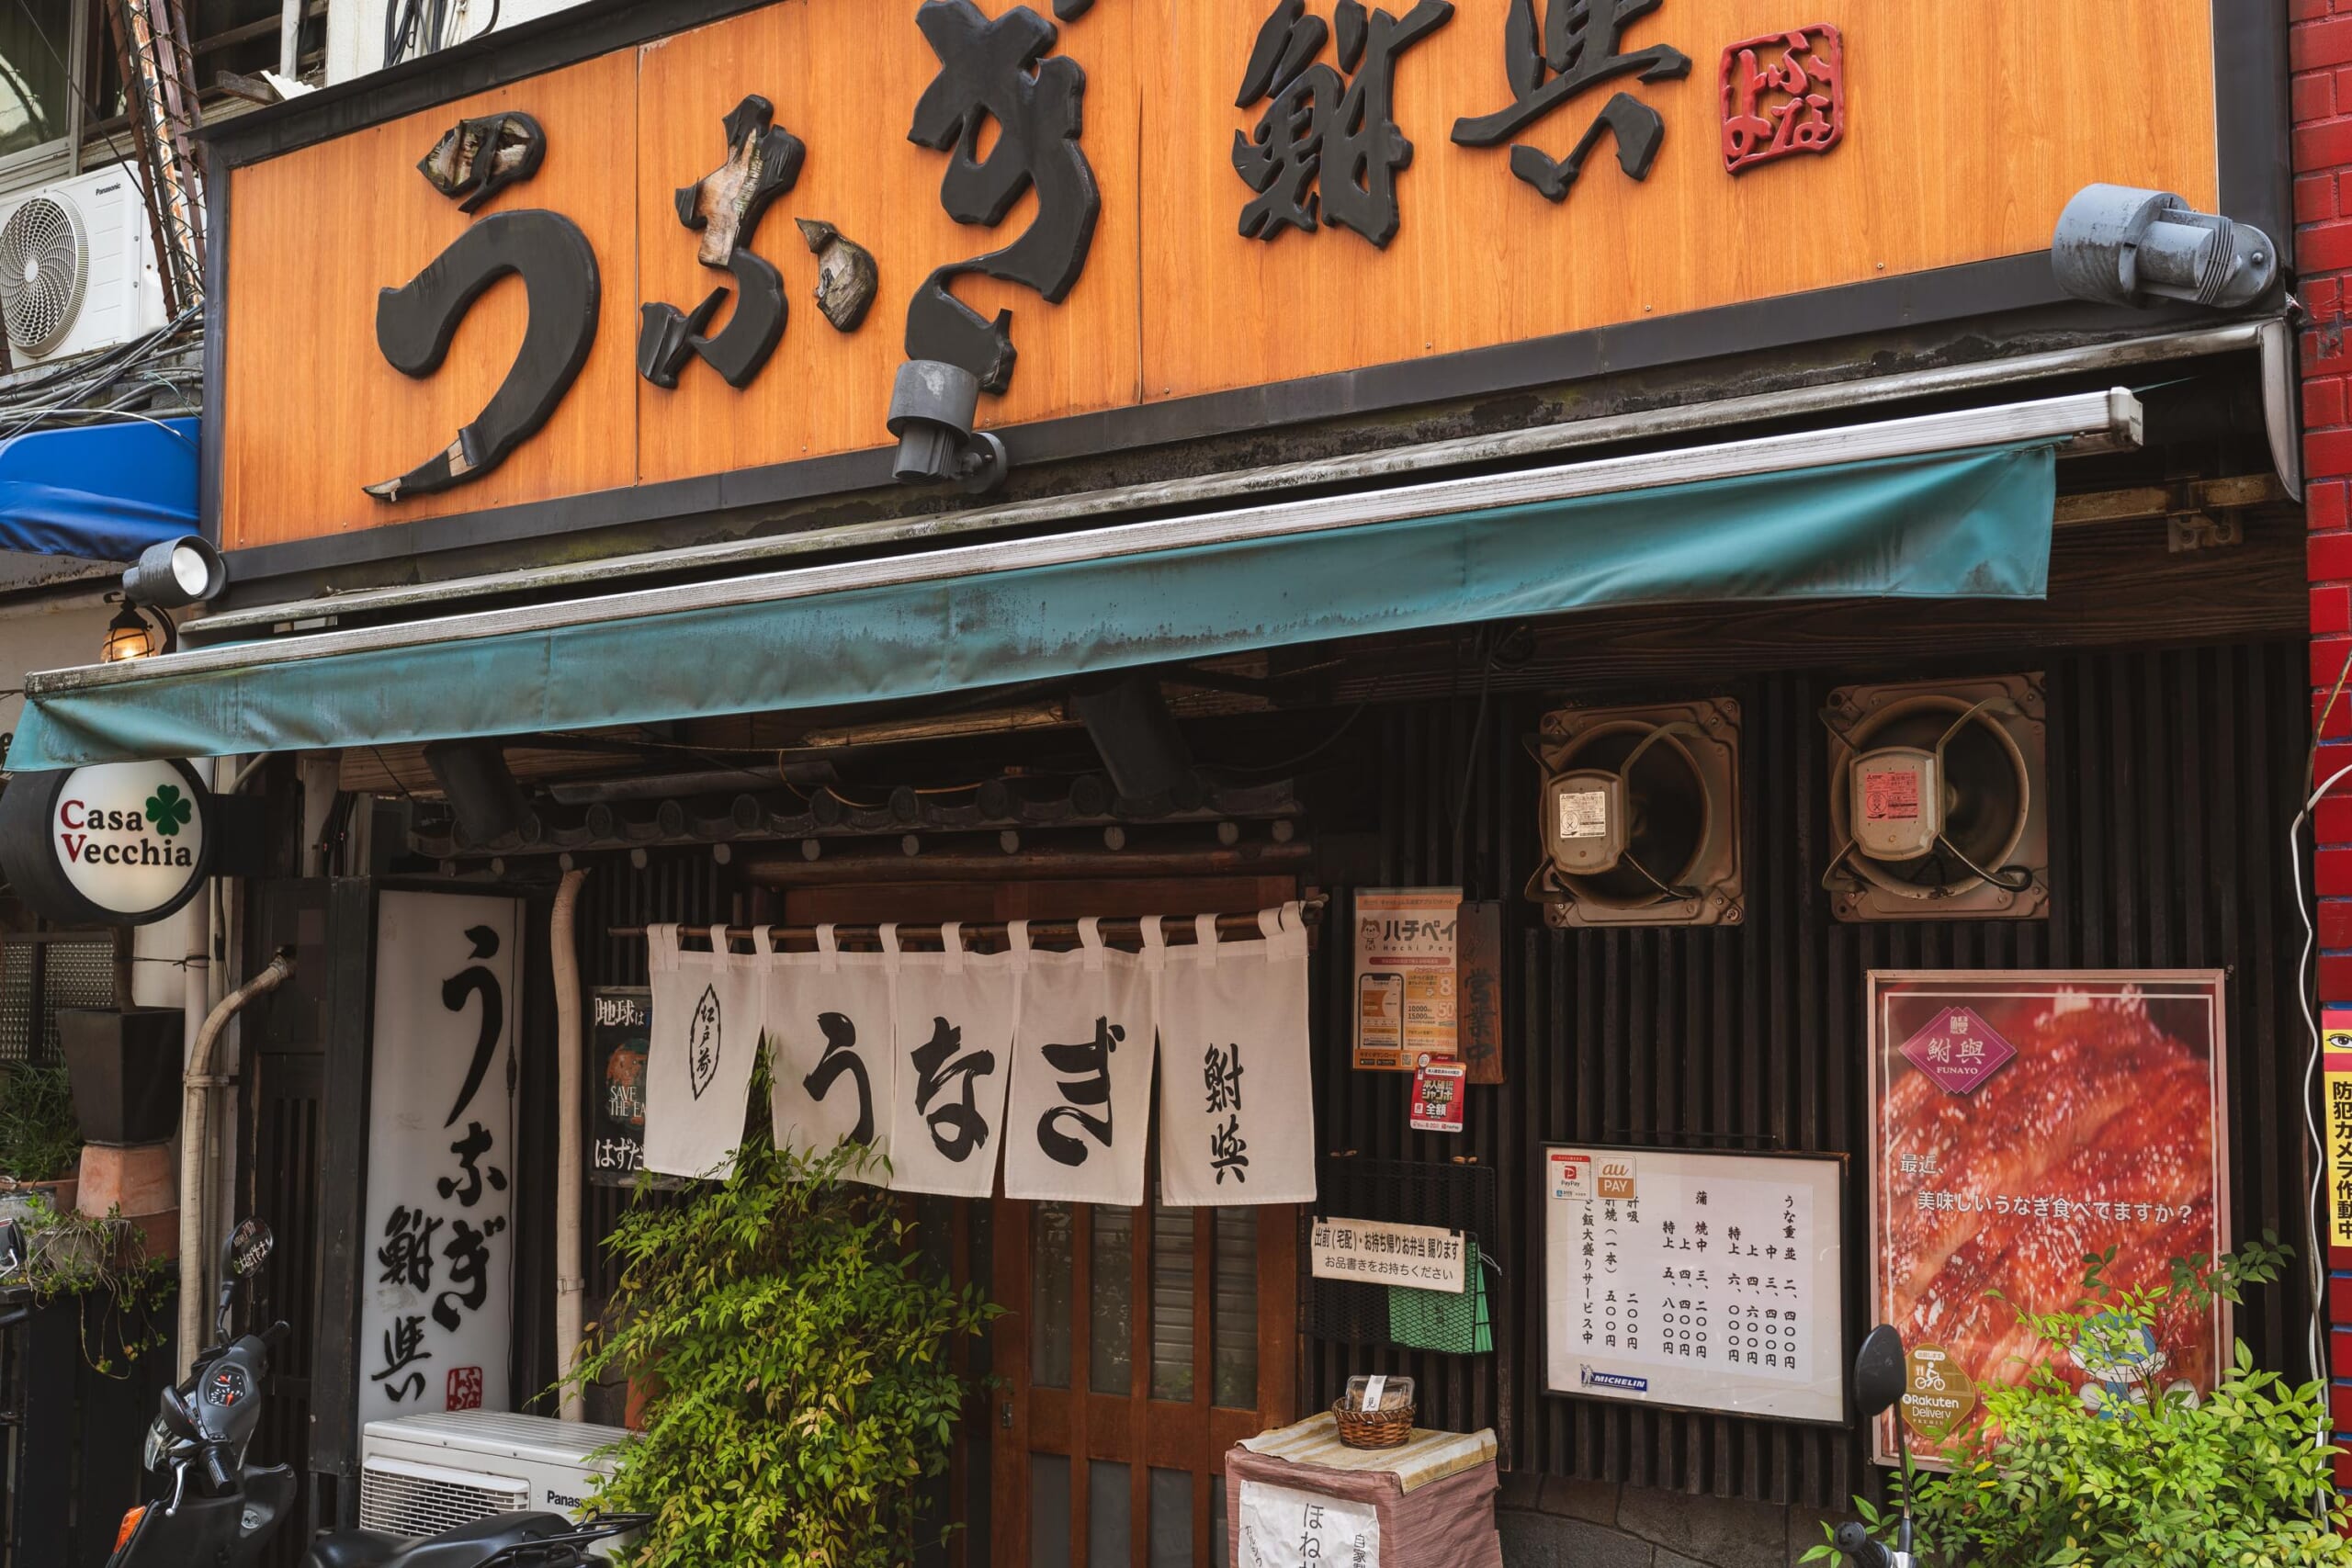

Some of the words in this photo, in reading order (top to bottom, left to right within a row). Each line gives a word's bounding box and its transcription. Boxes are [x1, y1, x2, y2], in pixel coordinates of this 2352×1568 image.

[61, 800, 143, 831] Casa
[61, 834, 192, 866] Vecchia
[1384, 920, 1456, 942] ハチペイ
[1429, 944, 1453, 953] Pay
[1937, 1066, 1978, 1075] FUNAYO
[609, 1086, 638, 1102] SAVE
[803, 1011, 1126, 1168] うなぎ
[609, 1100, 629, 1117] THE
[1426, 1103, 1447, 1117] 全額
[2333, 1081, 2352, 1239] 防犯カメラ作動中
[1602, 1164, 1629, 1177] au
[1604, 1179, 1628, 1192] PAY
[1783, 1195, 1796, 1239] うな重
[1663, 1221, 1676, 1249] 特上
[1728, 1226, 1741, 1255] 特上
[1679, 1238, 1690, 1250] 上
[1747, 1245, 1758, 1257] 上
[1765, 1245, 1778, 1259] 中
[1784, 1247, 1797, 1261] 並
[1325, 1256, 1453, 1280] お品書きをお持ちください
[1582, 1200, 1594, 1345] ご飯大盛りサービス中
[1594, 1375, 1645, 1388] MICHELIN
[1912, 1394, 1960, 1409] Rakuten
[547, 1489, 582, 1508] Panas
